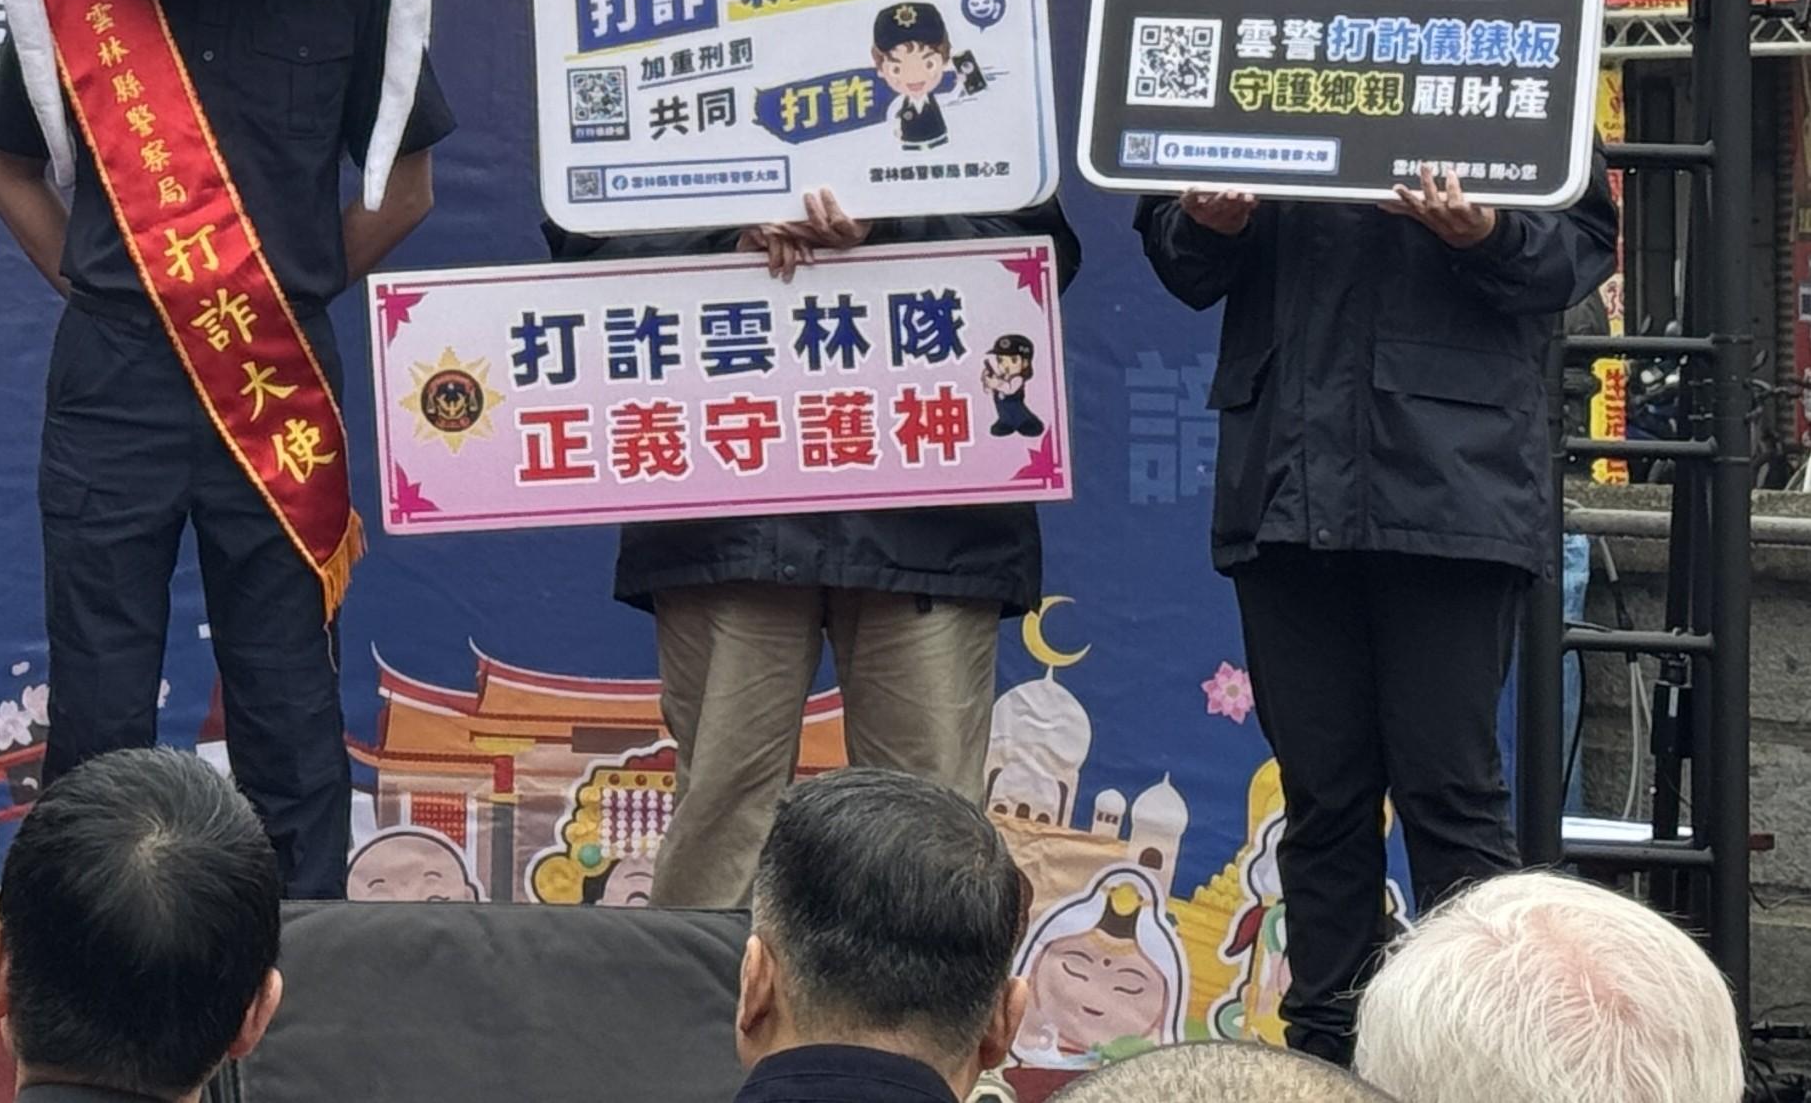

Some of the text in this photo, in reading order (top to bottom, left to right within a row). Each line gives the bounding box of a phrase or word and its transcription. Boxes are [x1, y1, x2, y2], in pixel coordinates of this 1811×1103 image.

[85, 0, 189, 207] 雲林縣警察局
[639, 37, 754, 82] 加重刑罰
[648, 75, 876, 141] 共同 打詐
[1229, 68, 1405, 117] 守護鄉親
[1411, 74, 1552, 122] 顧財產
[163, 222, 339, 486] 打詐大使
[508, 287, 970, 388] 打詐雲林隊
[515, 385, 973, 484] 正義守護神
